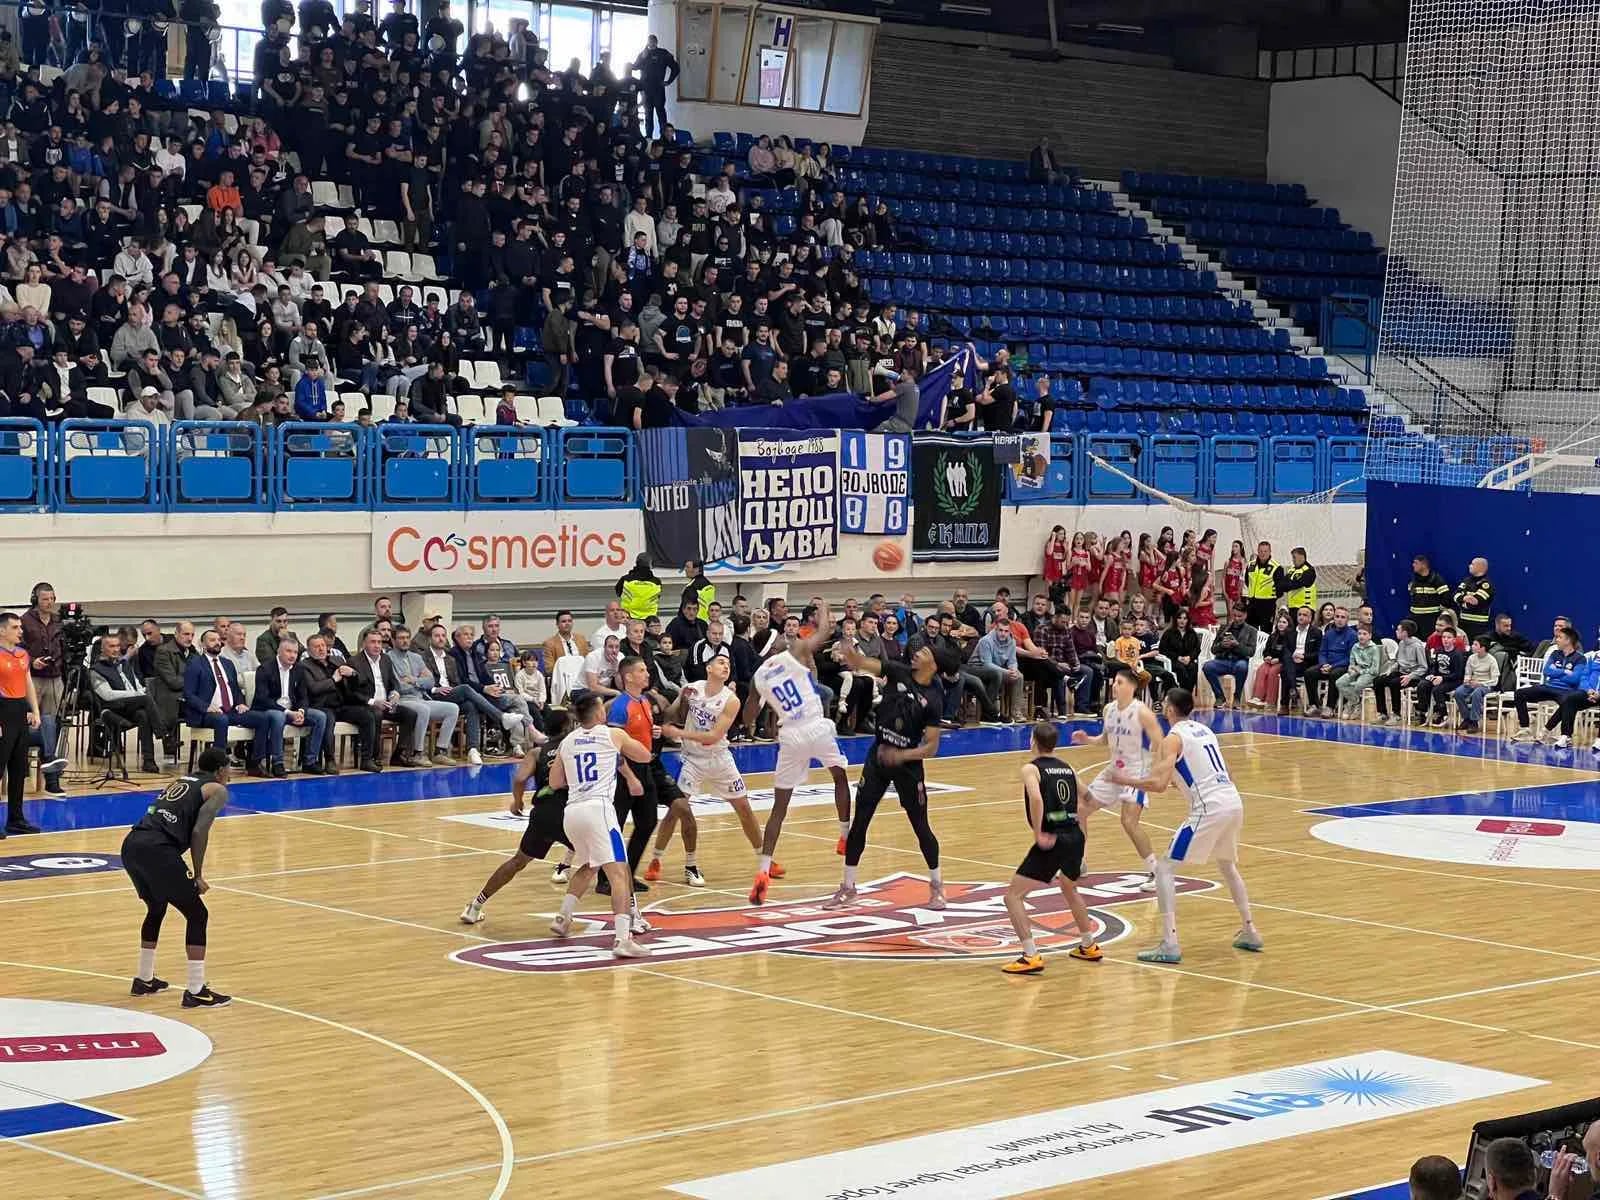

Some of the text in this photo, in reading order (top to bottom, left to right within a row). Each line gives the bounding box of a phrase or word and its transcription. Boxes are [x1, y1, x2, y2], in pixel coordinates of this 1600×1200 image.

[888, 438, 905, 469] 9
[742, 466, 834, 498] НЕПО
[644, 486, 689, 512] UNITED
[744, 496, 834, 530] ДНОШ
[387, 525, 626, 572] Cosmetics
[745, 527, 834, 562] ЉИВИ
[772, 679, 803, 711] 99
[574, 752, 599, 783] 12
[1203, 744, 1224, 772] 11
[1057, 779, 1070, 804] 0
